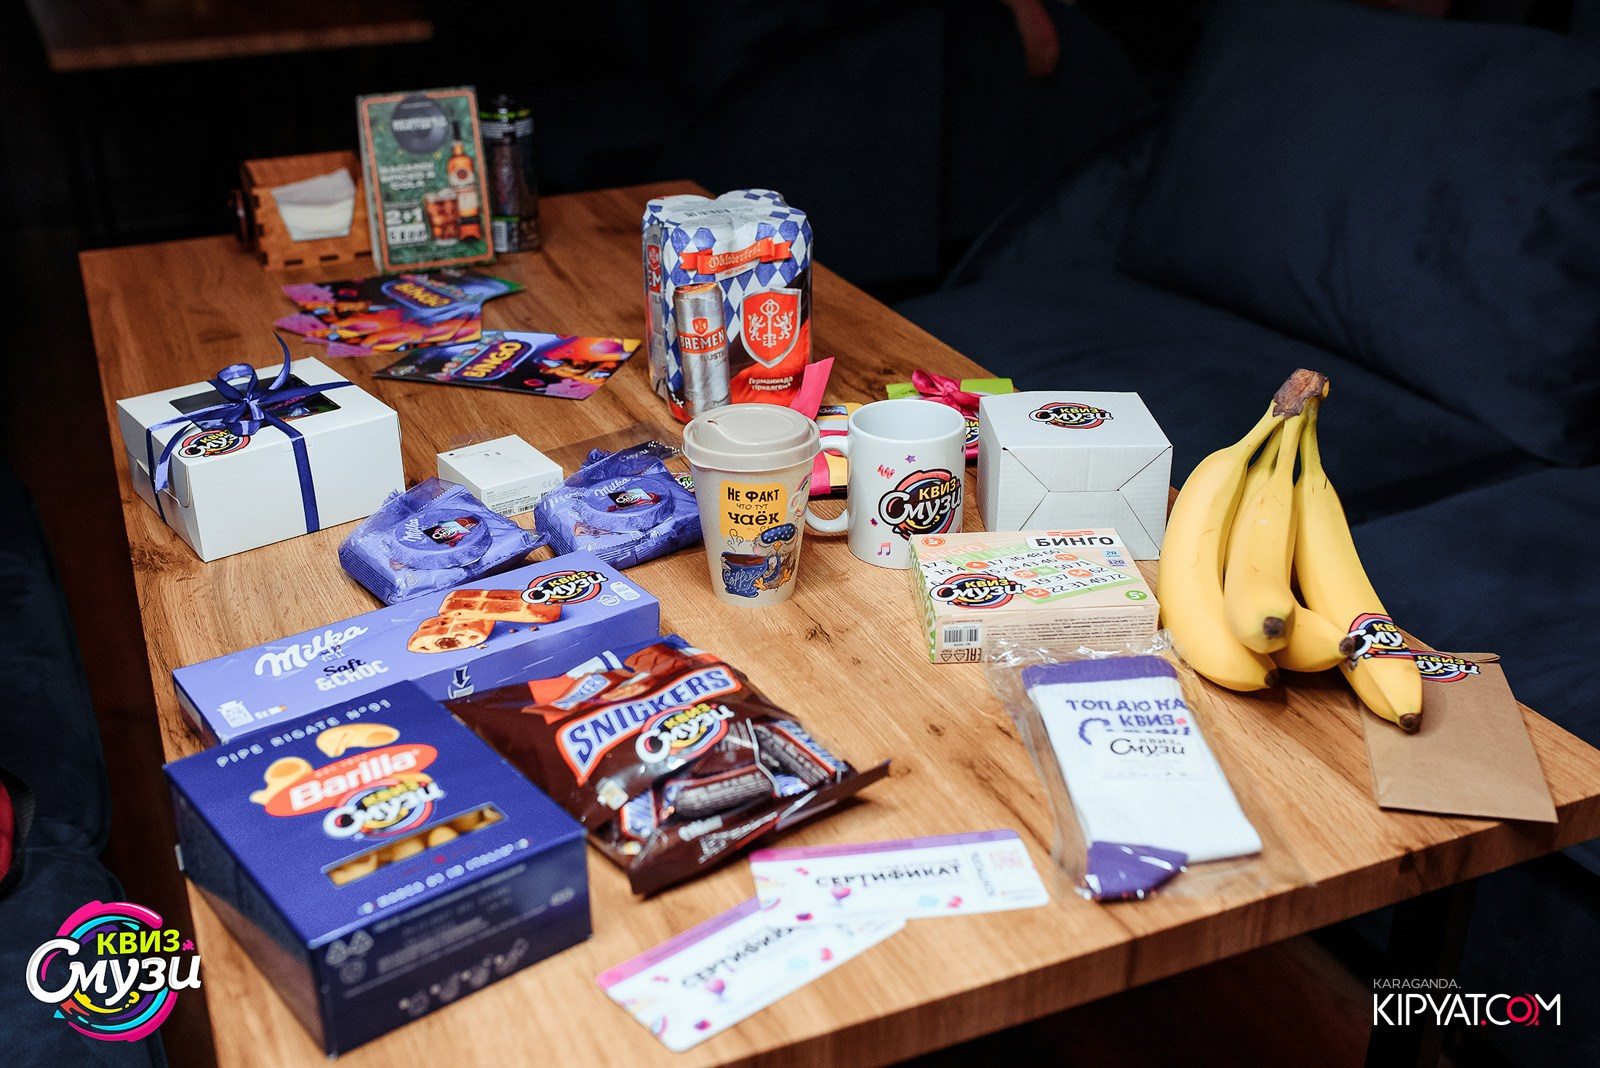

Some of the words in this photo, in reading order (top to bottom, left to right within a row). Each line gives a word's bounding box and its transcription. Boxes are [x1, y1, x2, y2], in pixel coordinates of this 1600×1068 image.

[680, 331, 725, 351] BREMEN
[463, 342, 522, 378] BINGO
[1030, 408, 1113, 422] Смузи
[179, 434, 237, 457] Смуз
[594, 478, 631, 497] Milka
[745, 489, 779, 502] ФАКТ
[919, 479, 956, 500] КВИЗ
[879, 484, 961, 525] Смузи
[1035, 537, 1114, 547] БИНГО
[522, 573, 608, 604] Смузи
[548, 571, 588, 587] КВИЗ
[965, 579, 1009, 588] КВИЗ
[930, 583, 1023, 602] Смузи
[1047, 585, 1069, 593] 22
[1373, 623, 1398, 633] КВ
[255, 626, 368, 676] Milka
[1347, 629, 1403, 657] Сму
[323, 659, 366, 676] Soft
[1416, 660, 1481, 675] музи
[1417, 655, 1465, 665] КВИЗ
[1154, 698, 1188, 711] НА
[569, 669, 731, 765] SNICKERS
[1119, 714, 1175, 727] КВИЗ
[635, 705, 735, 763] Смузи
[1110, 738, 1185, 757] Смузи
[289, 749, 416, 811] Barilla
[323, 782, 445, 837] Смузи
[815, 864, 961, 887] СЕРТИФИКАТ
